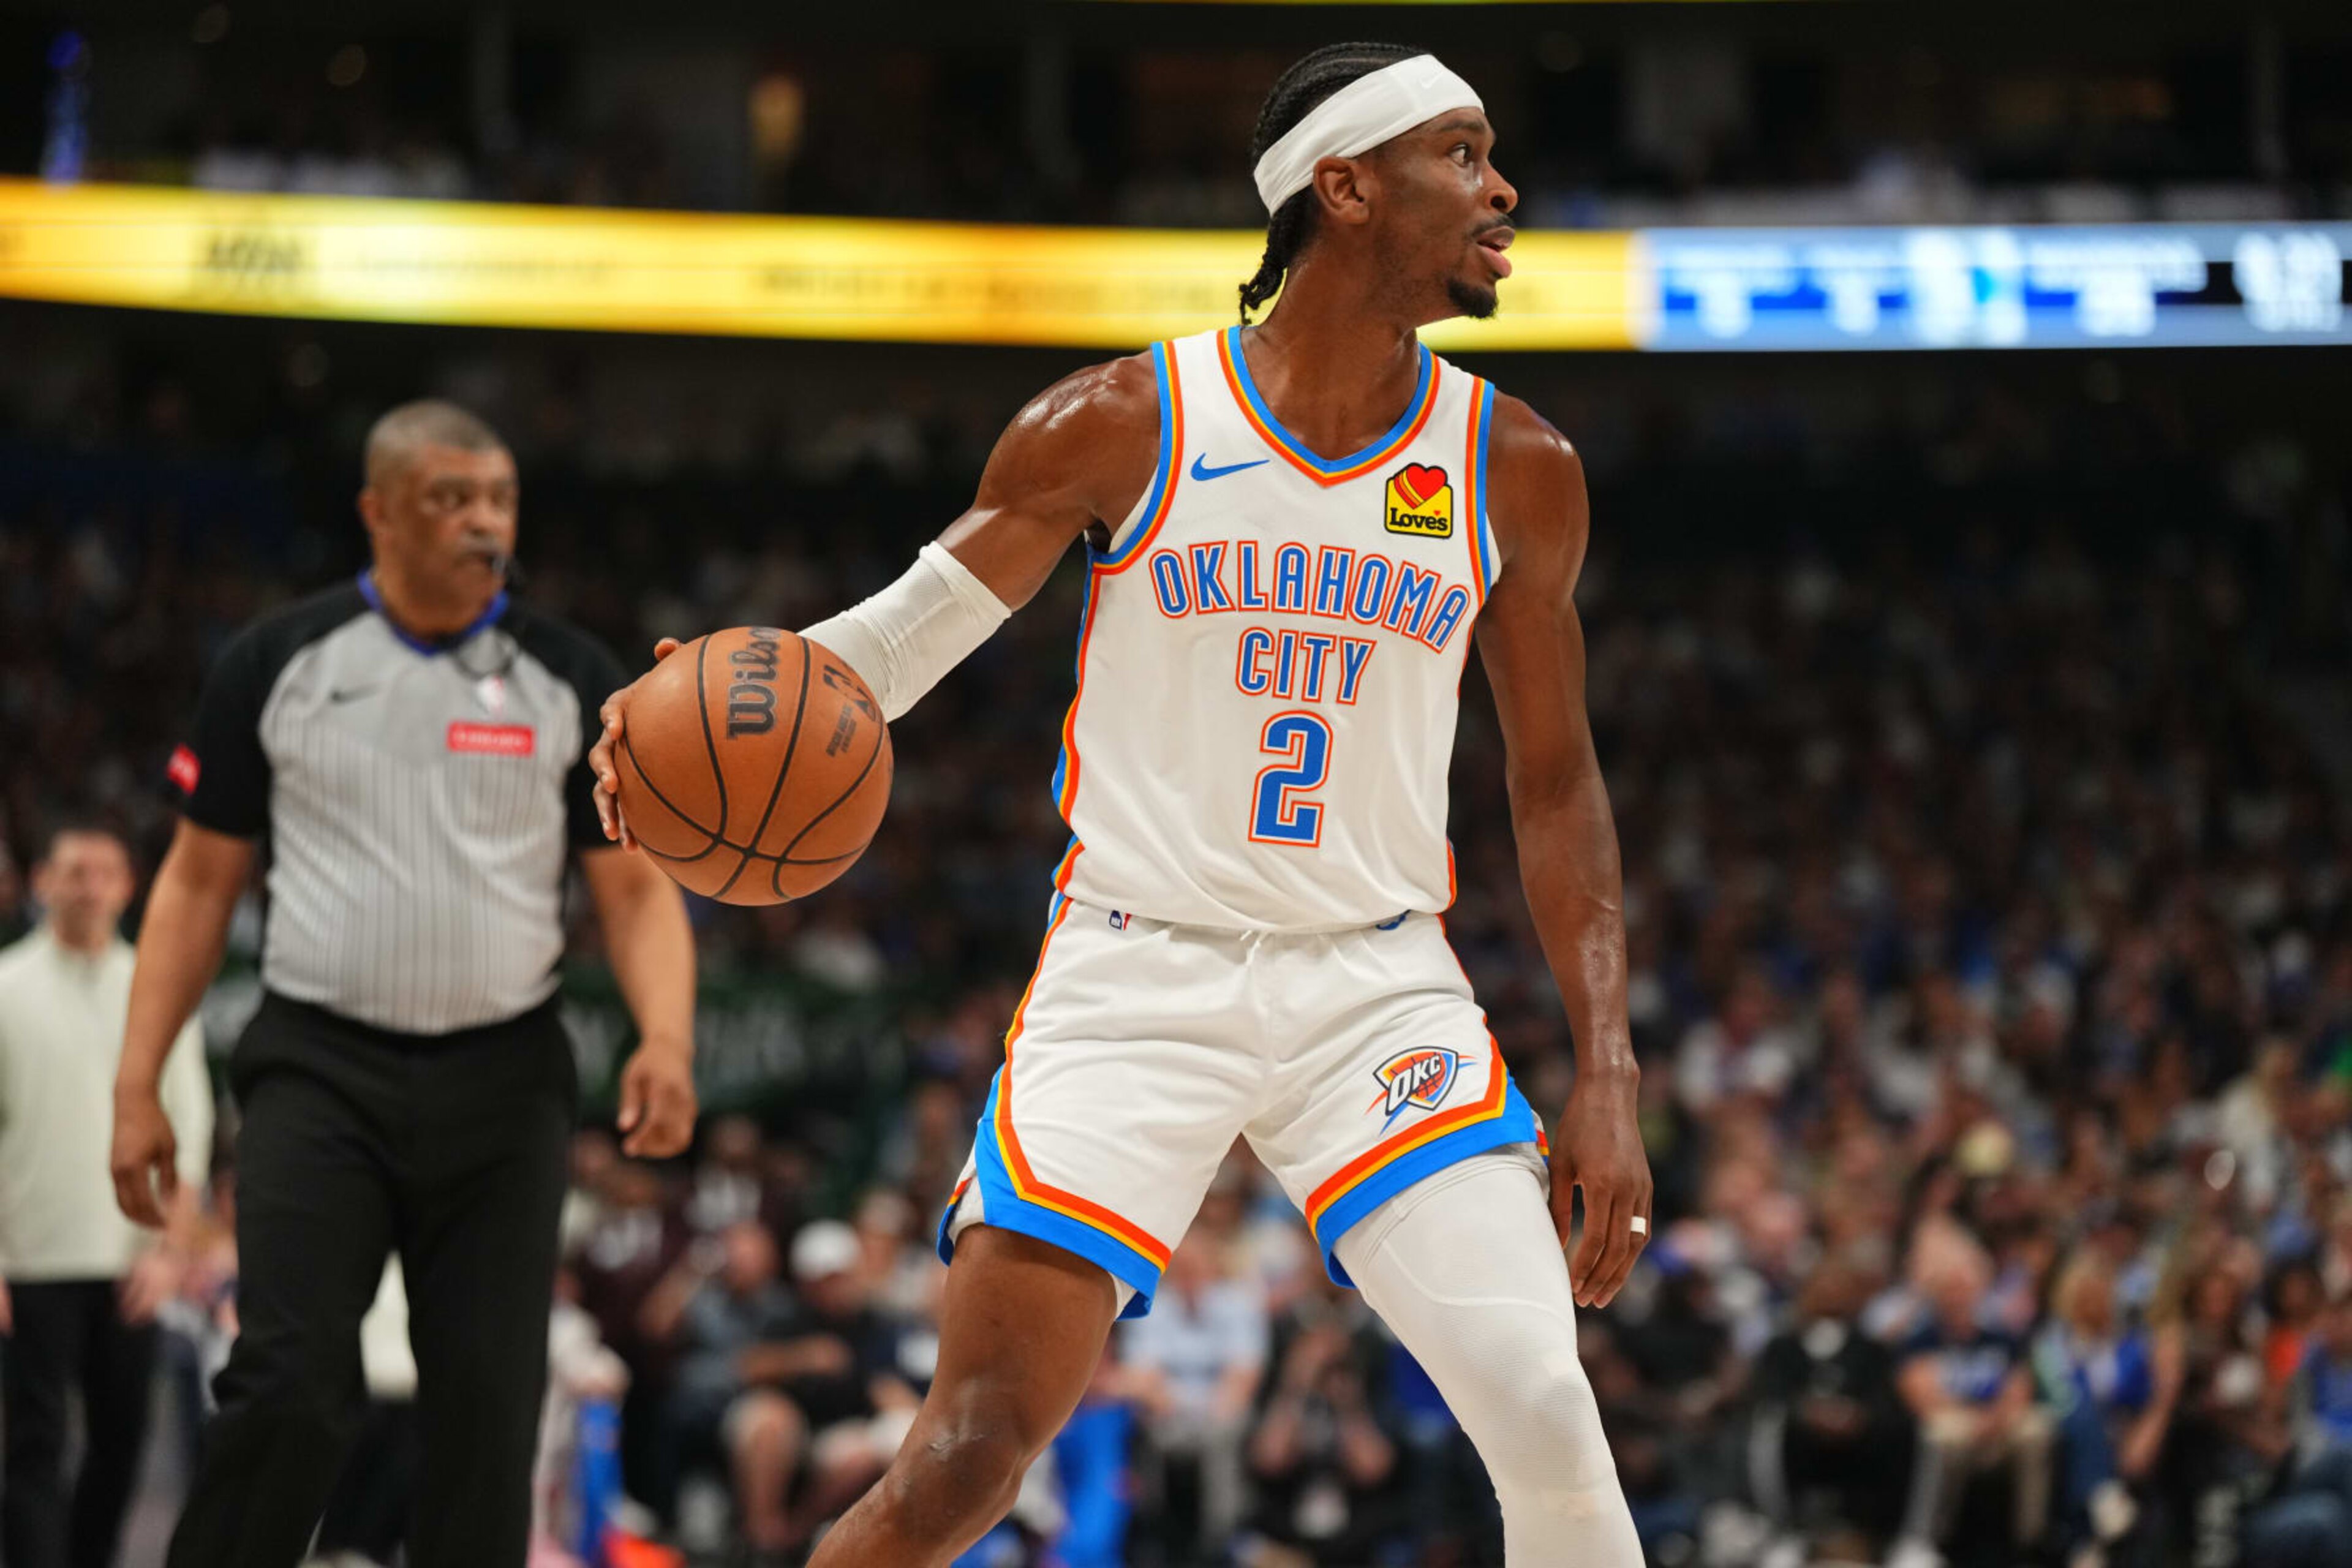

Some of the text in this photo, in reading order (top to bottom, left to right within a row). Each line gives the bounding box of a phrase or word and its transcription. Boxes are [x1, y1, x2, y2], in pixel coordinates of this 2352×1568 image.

[1149, 540, 1471, 654] OKLAHOMA
[1236, 627, 1377, 706] CITY
[1248, 710, 1333, 848] 2
[1385, 1055, 1441, 1115] OKC
